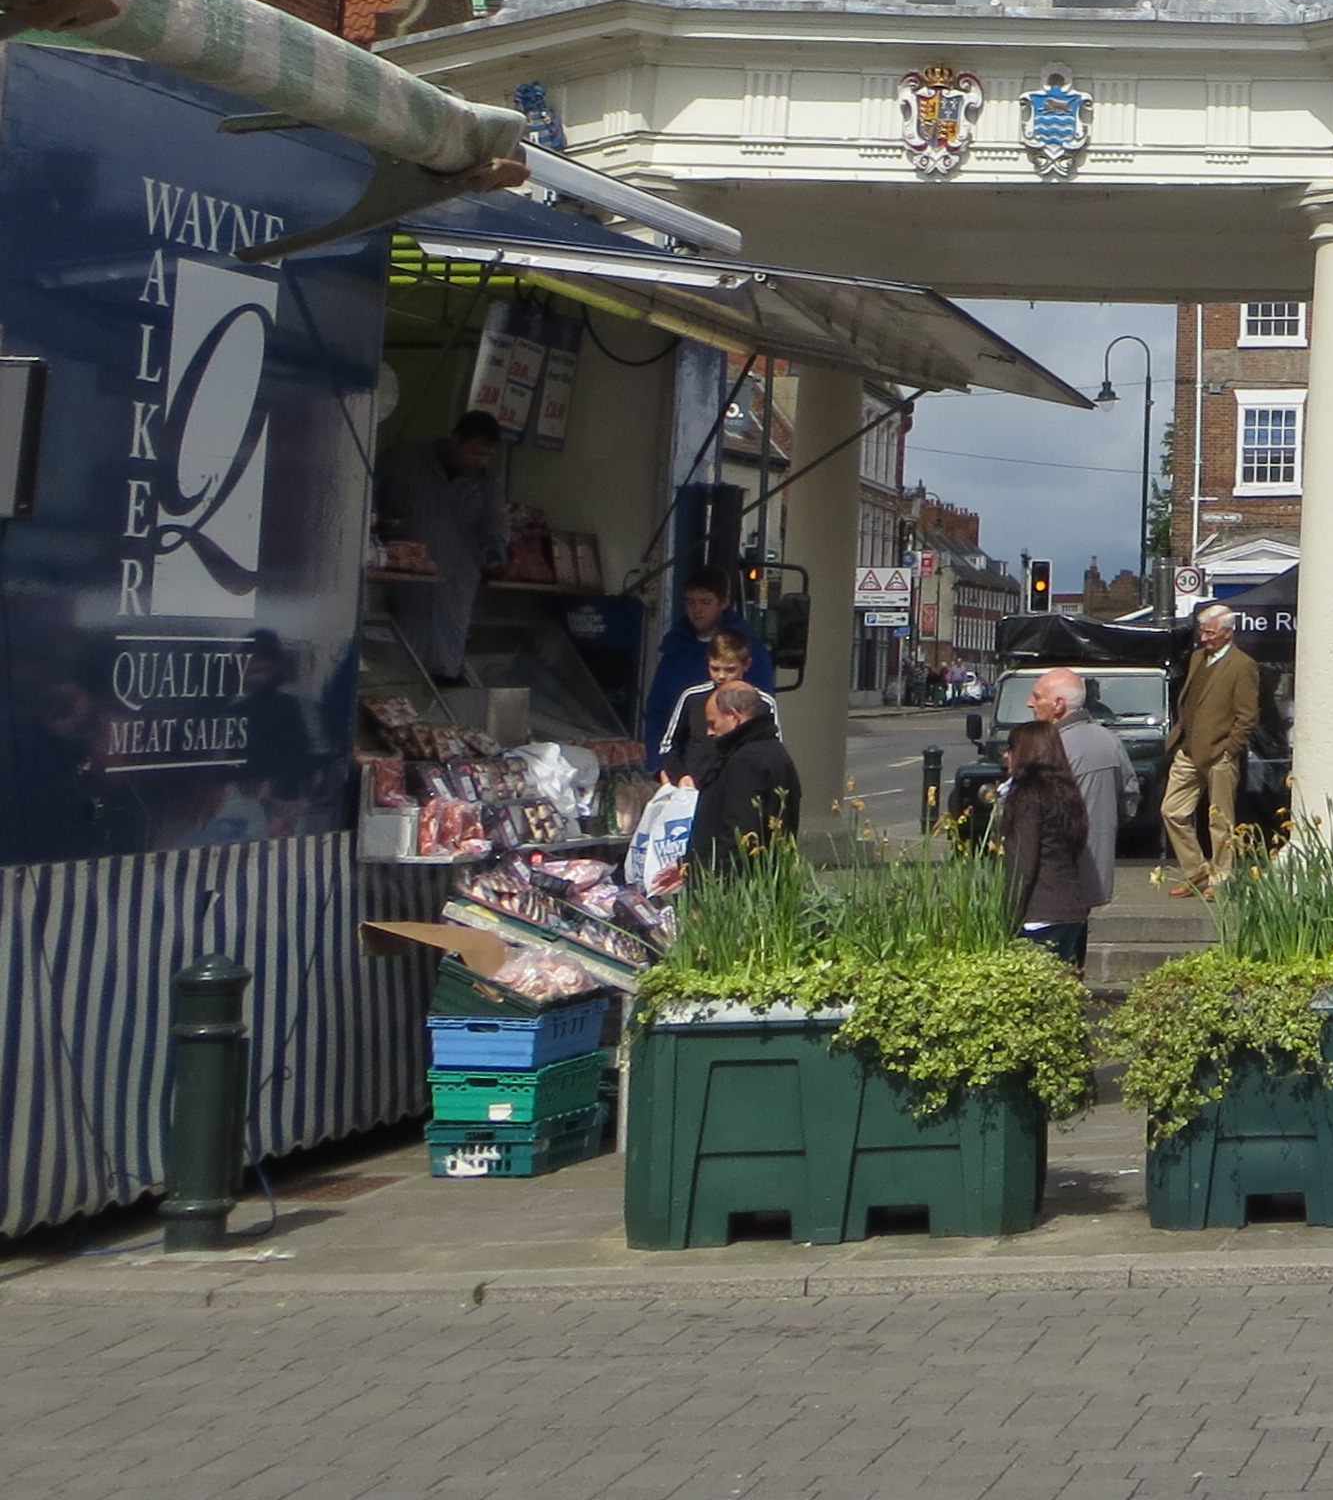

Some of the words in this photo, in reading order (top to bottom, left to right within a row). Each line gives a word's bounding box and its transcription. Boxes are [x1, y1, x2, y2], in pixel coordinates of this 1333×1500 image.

[1178, 575, 1197, 586] 30
[113, 651, 254, 711] QUALITY
[108, 719, 177, 755] MEAT
[182, 717, 248, 751] SALES
